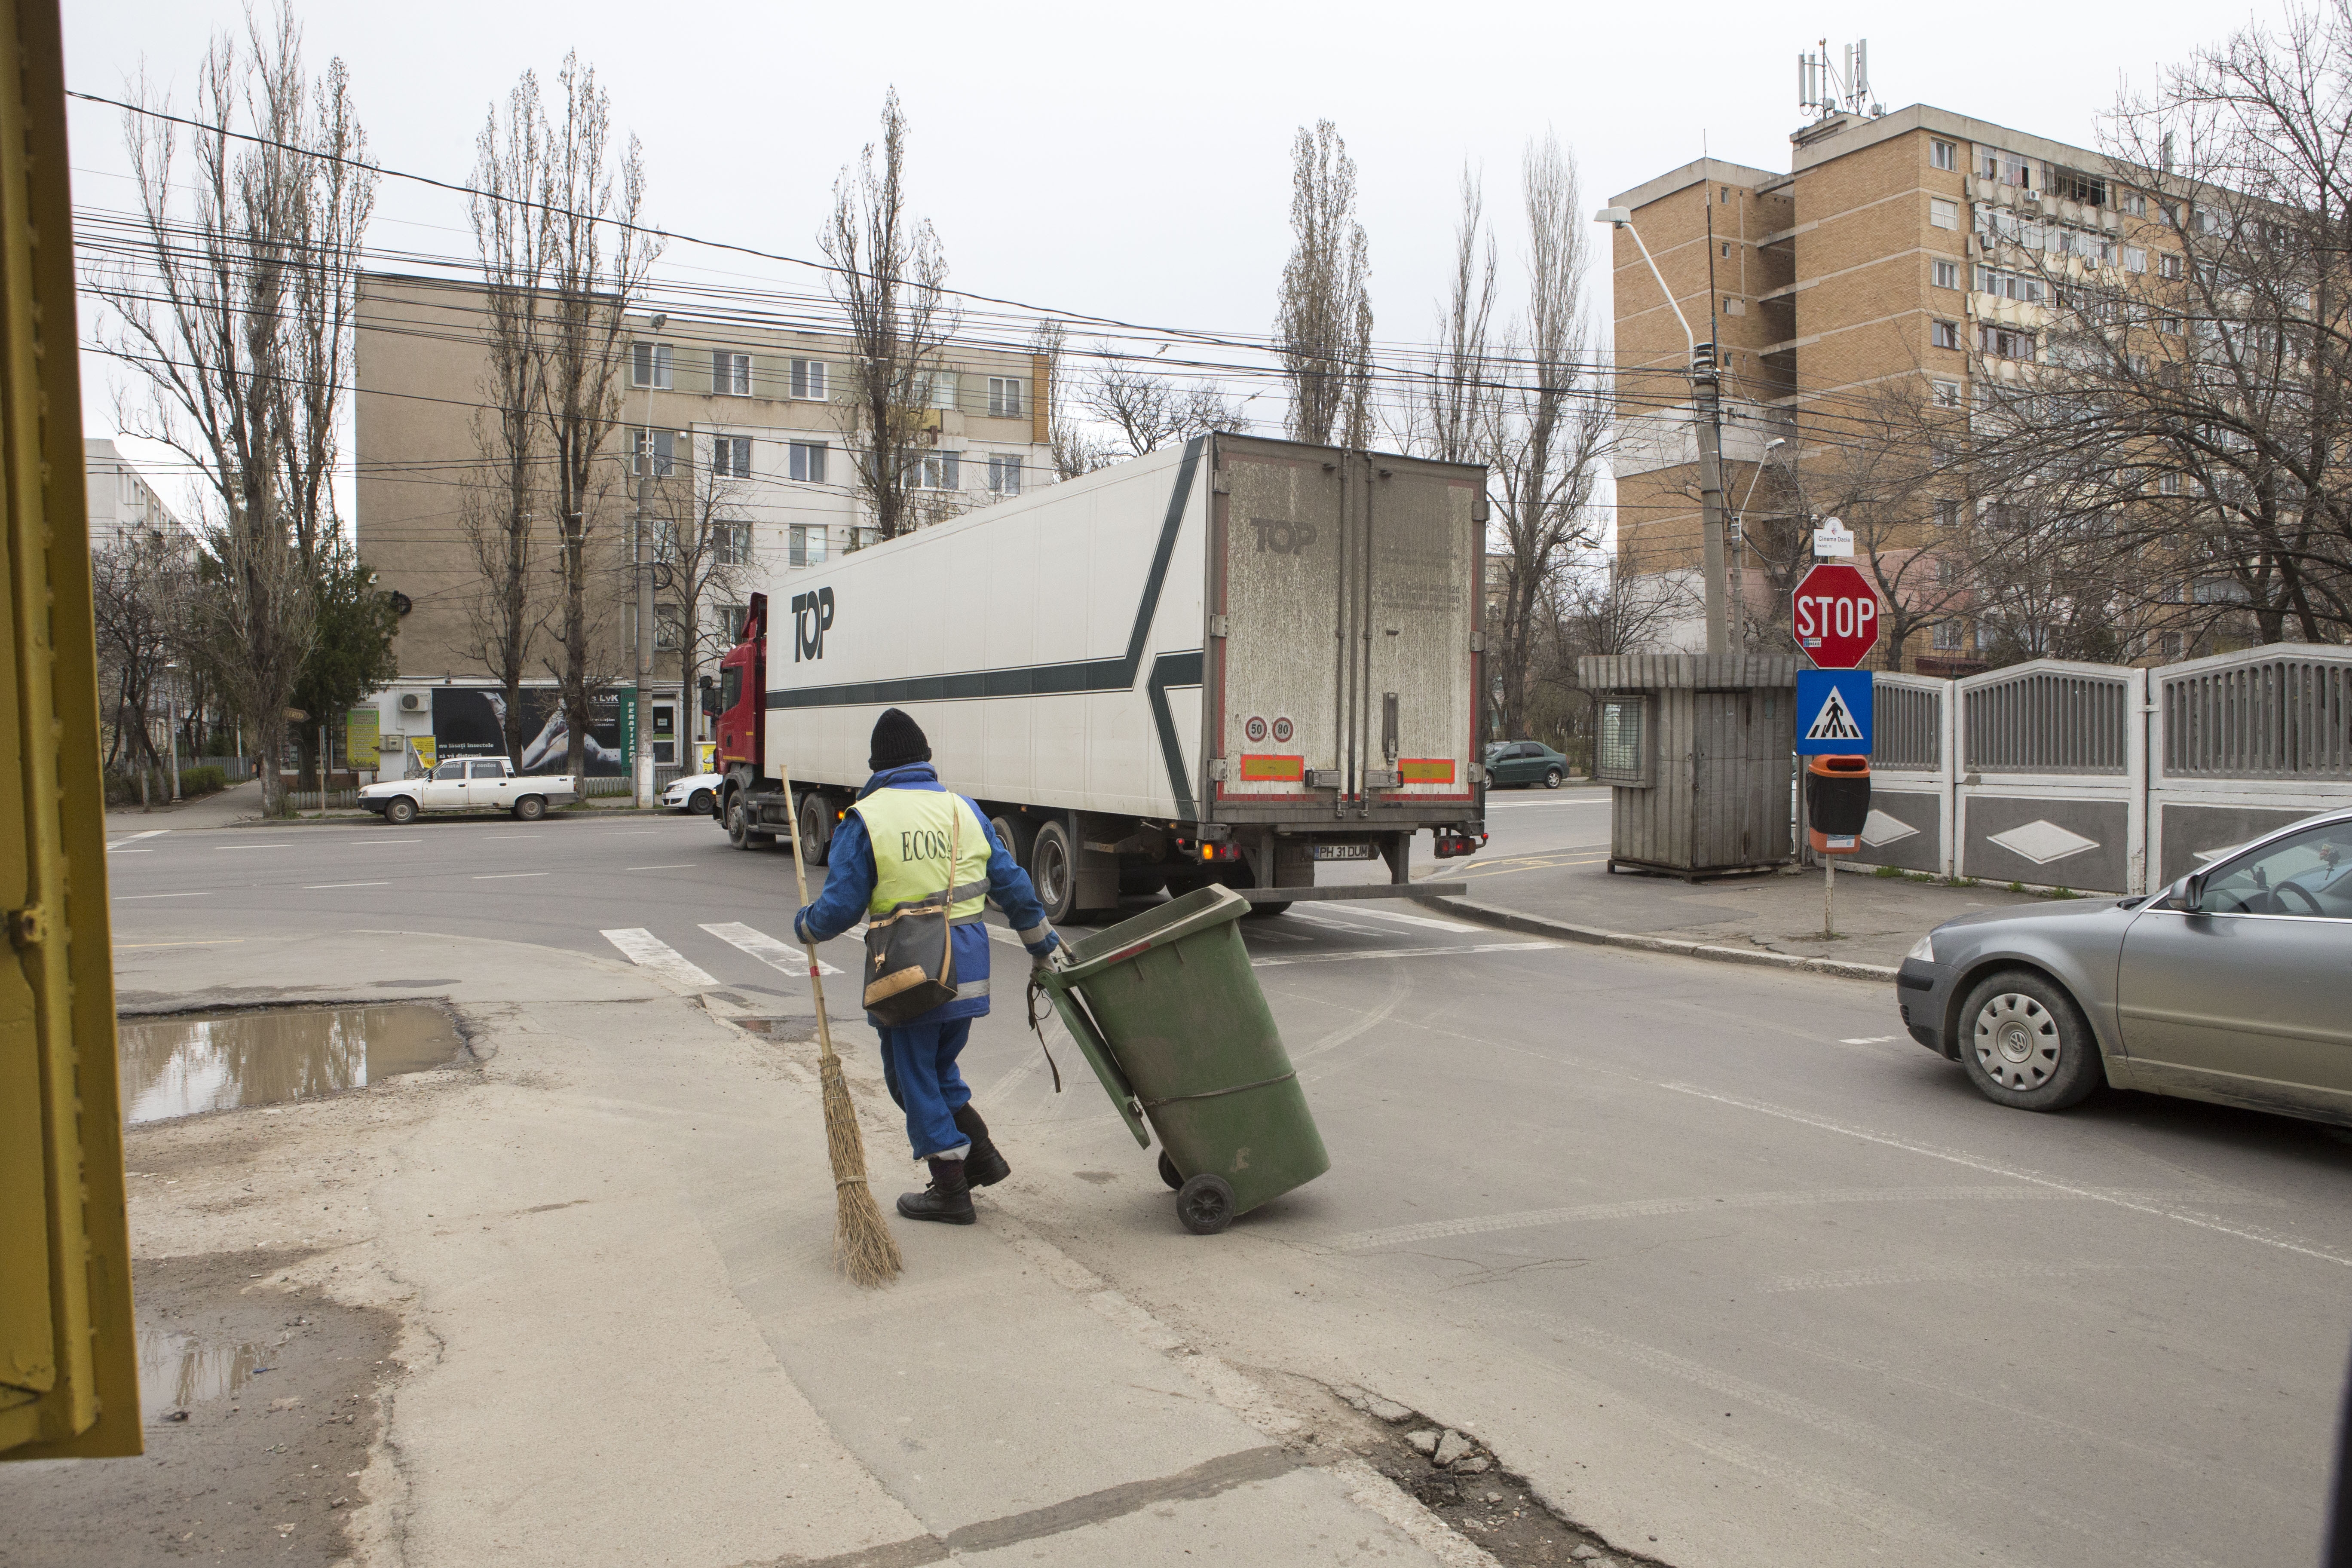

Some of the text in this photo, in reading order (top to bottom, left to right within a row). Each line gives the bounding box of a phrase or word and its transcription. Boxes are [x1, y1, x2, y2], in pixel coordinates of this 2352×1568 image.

[1250, 517, 1317, 555] TOP
[792, 586, 835, 663] TOP
[1798, 596, 1874, 638] STOP
[1251, 724, 1262, 734] 50
[1278, 724, 1289, 735] 80
[1320, 846, 1367, 858] PH 31 DUM
